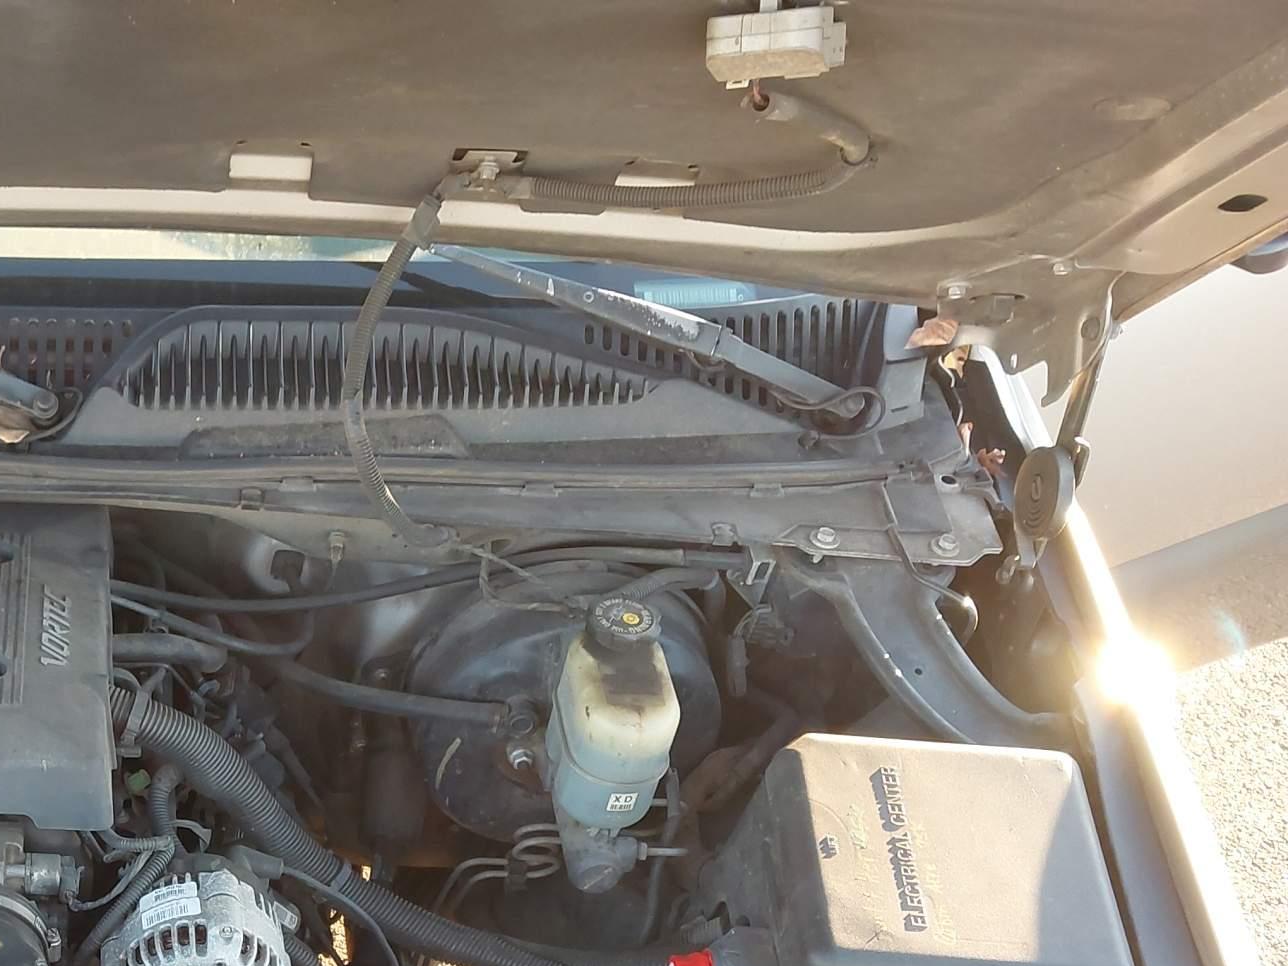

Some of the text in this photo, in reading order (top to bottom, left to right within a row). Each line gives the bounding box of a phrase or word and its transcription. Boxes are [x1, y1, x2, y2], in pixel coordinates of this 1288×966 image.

[40, 583, 72, 666] VORTEC
[877, 765, 906, 829] CENTER
[892, 831, 928, 931] ELECTRICAL
